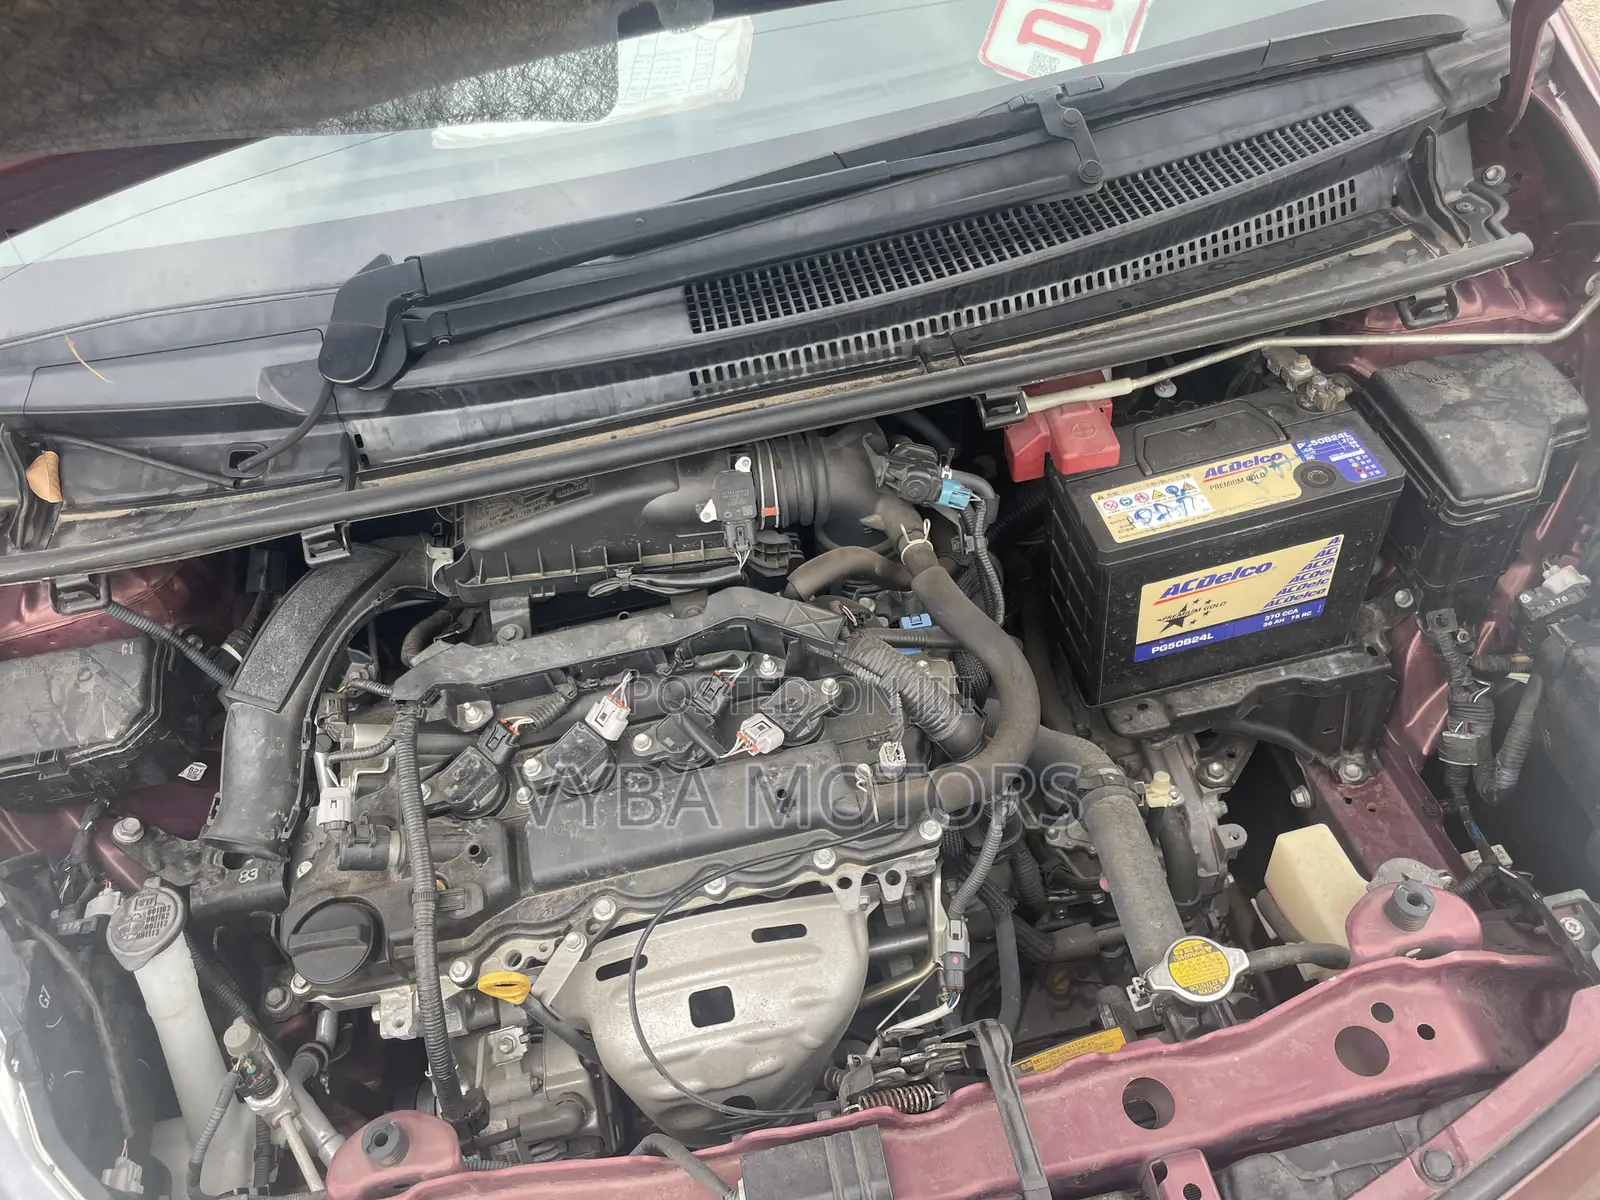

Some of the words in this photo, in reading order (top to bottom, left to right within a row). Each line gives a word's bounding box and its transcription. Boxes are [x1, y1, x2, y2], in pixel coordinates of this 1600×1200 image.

[1203, 452, 1283, 479] ACDelco
[1209, 478, 1245, 491] PREMIUM
[1245, 471, 1266, 483] GOLD
[1328, 536, 1341, 546] A
[1314, 547, 1338, 559] AC
[1159, 562, 1273, 600] ACDelco
[1263, 588, 1327, 608] ACDelco
[1162, 606, 1202, 622] PREMIUM
[1203, 601, 1227, 612] GOLD
[1264, 612, 1281, 621] 370
[1281, 608, 1298, 616] CCA
[1151, 633, 1214, 654] PG50B24L
